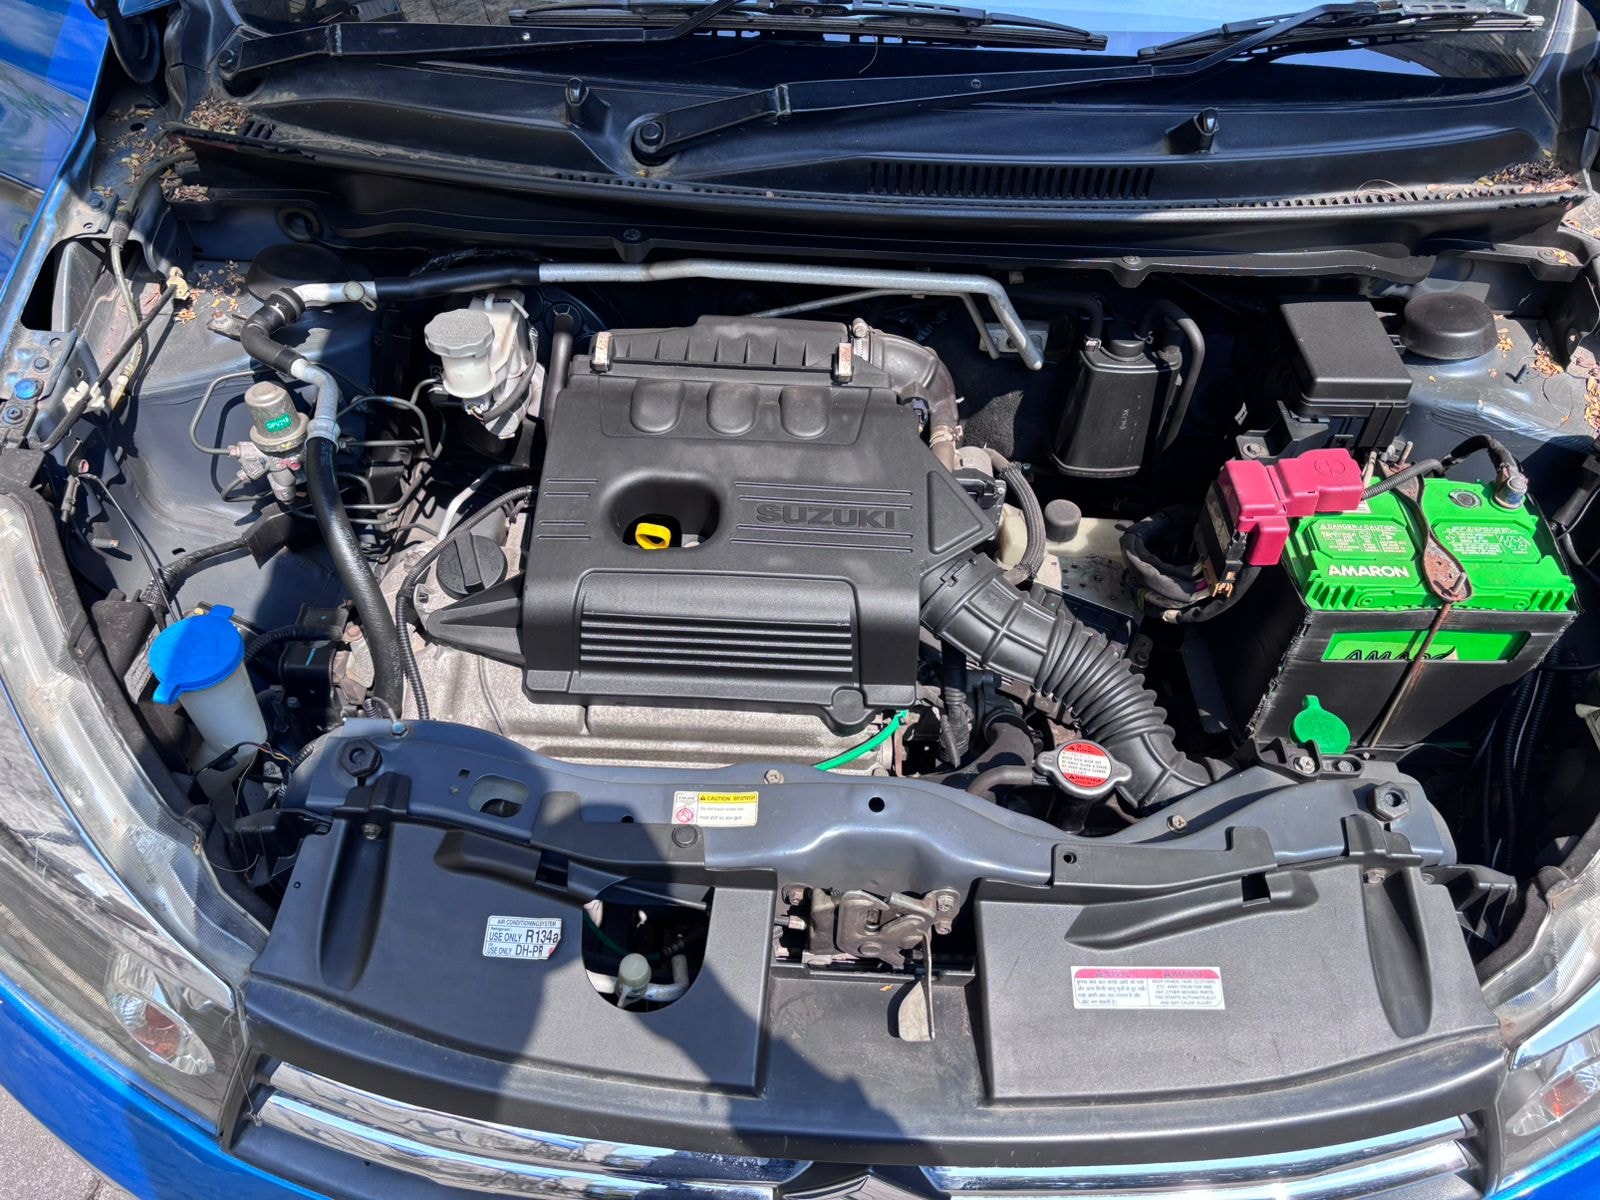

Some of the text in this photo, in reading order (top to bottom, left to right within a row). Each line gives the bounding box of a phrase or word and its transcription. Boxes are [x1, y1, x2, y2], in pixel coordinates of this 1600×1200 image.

[756, 503, 896, 529] SUZUKI
[1328, 564, 1410, 578] AMARON
[489, 929, 559, 944] USE ONLY R134a
[487, 947, 498, 955] USE
[498, 947, 513, 955] ONLY
